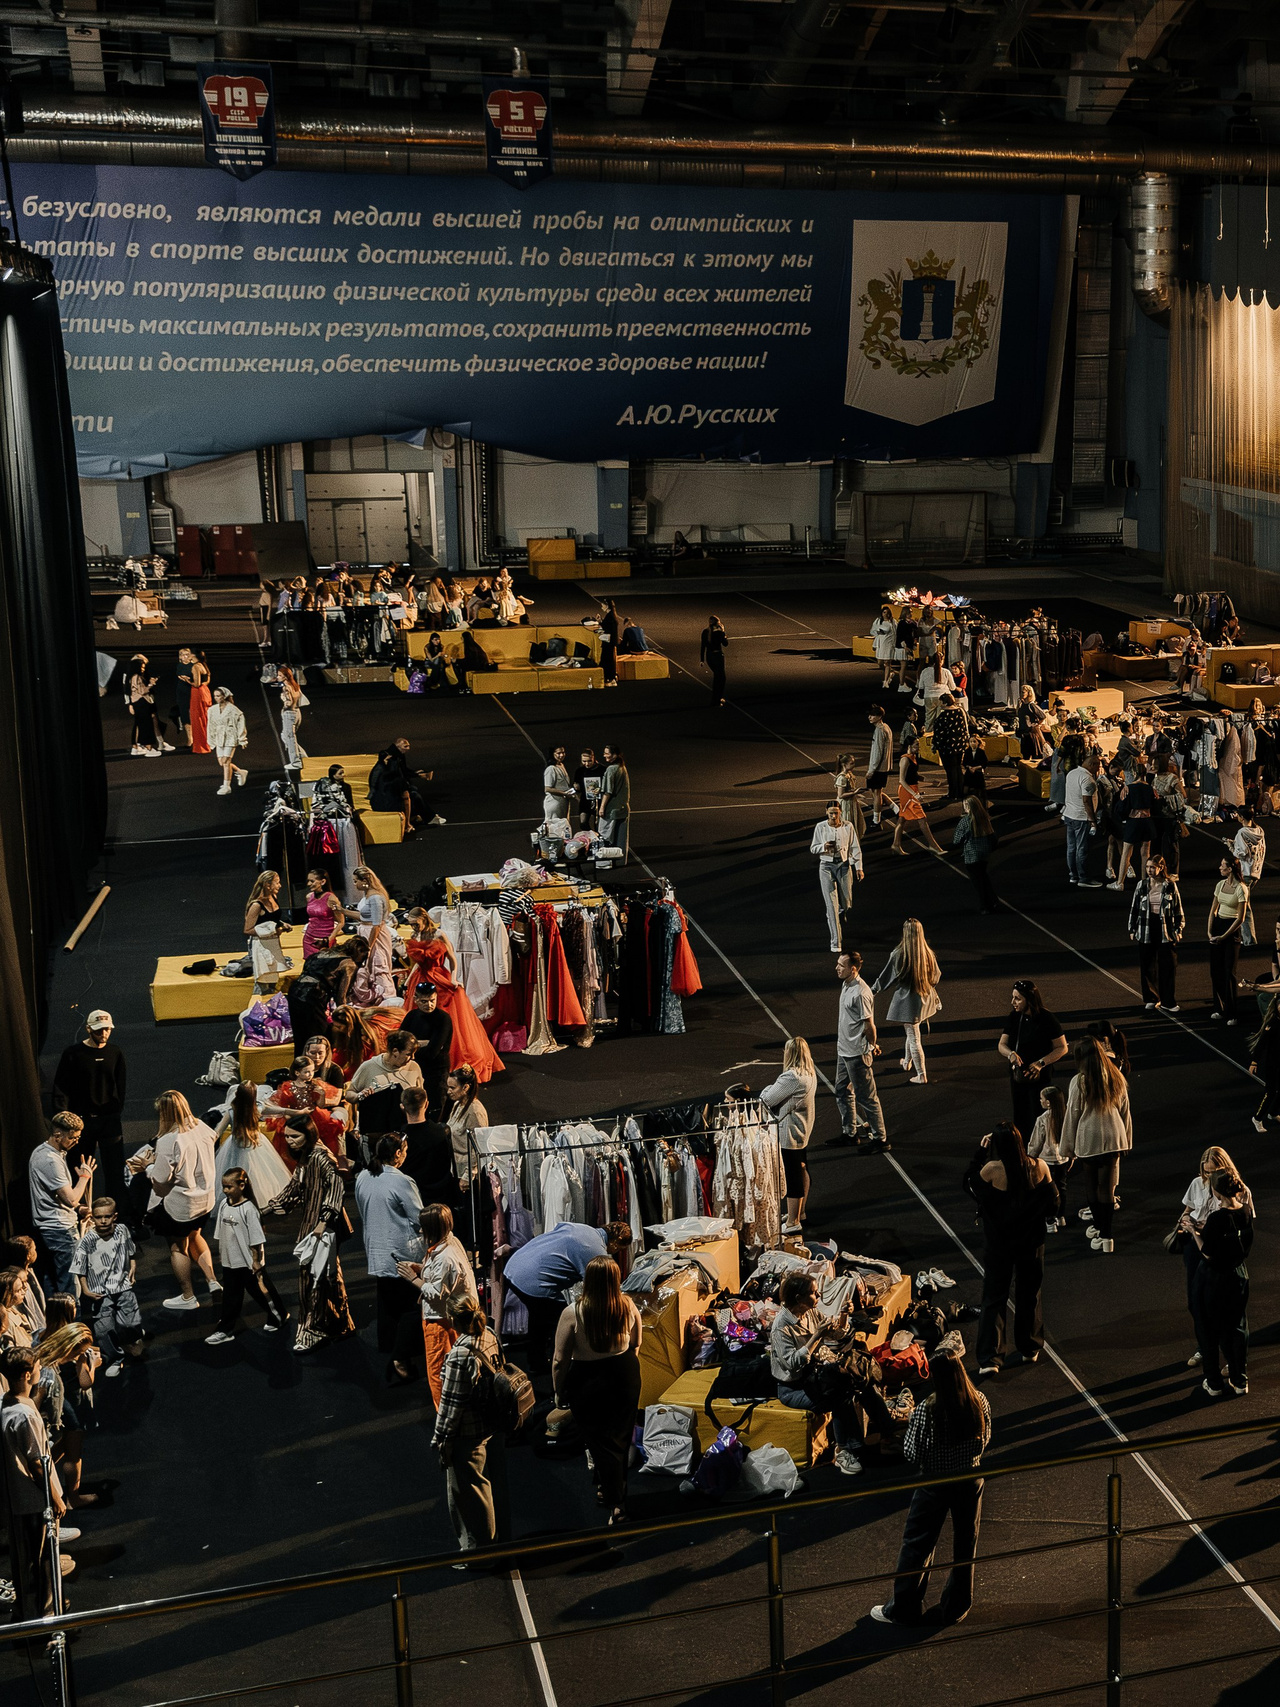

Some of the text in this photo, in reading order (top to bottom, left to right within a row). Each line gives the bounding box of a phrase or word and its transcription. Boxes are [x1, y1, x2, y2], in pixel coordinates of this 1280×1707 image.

[223, 86, 250, 107] 19
[509, 101, 525, 120] 5
[22, 195, 172, 224] безусловно,
[196, 205, 321, 225] являются
[333, 205, 421, 228] медали
[432, 209, 522, 230] высшей
[533, 210, 603, 235] пробы
[613, 216, 640, 231] на
[650, 213, 792, 234] олимпийских
[802, 220, 814, 234] и
[6, 238, 813, 273] таты в спорте высших достижений. Но двигаться к этому мы
[133, 281, 326, 304] популяризацию
[333, 281, 470, 306] физической
[477, 287, 589, 308] культуры
[596, 283, 657, 308] среди
[663, 288, 709, 303] всех
[713, 284, 812, 303] жителей
[139, 319, 322, 337] максимальных
[616, 322, 811, 342] преемственность
[139, 357, 152, 372] и
[465, 354, 593, 378] физическое
[596, 353, 693, 376] здоровье
[696, 351, 768, 372] нации!
